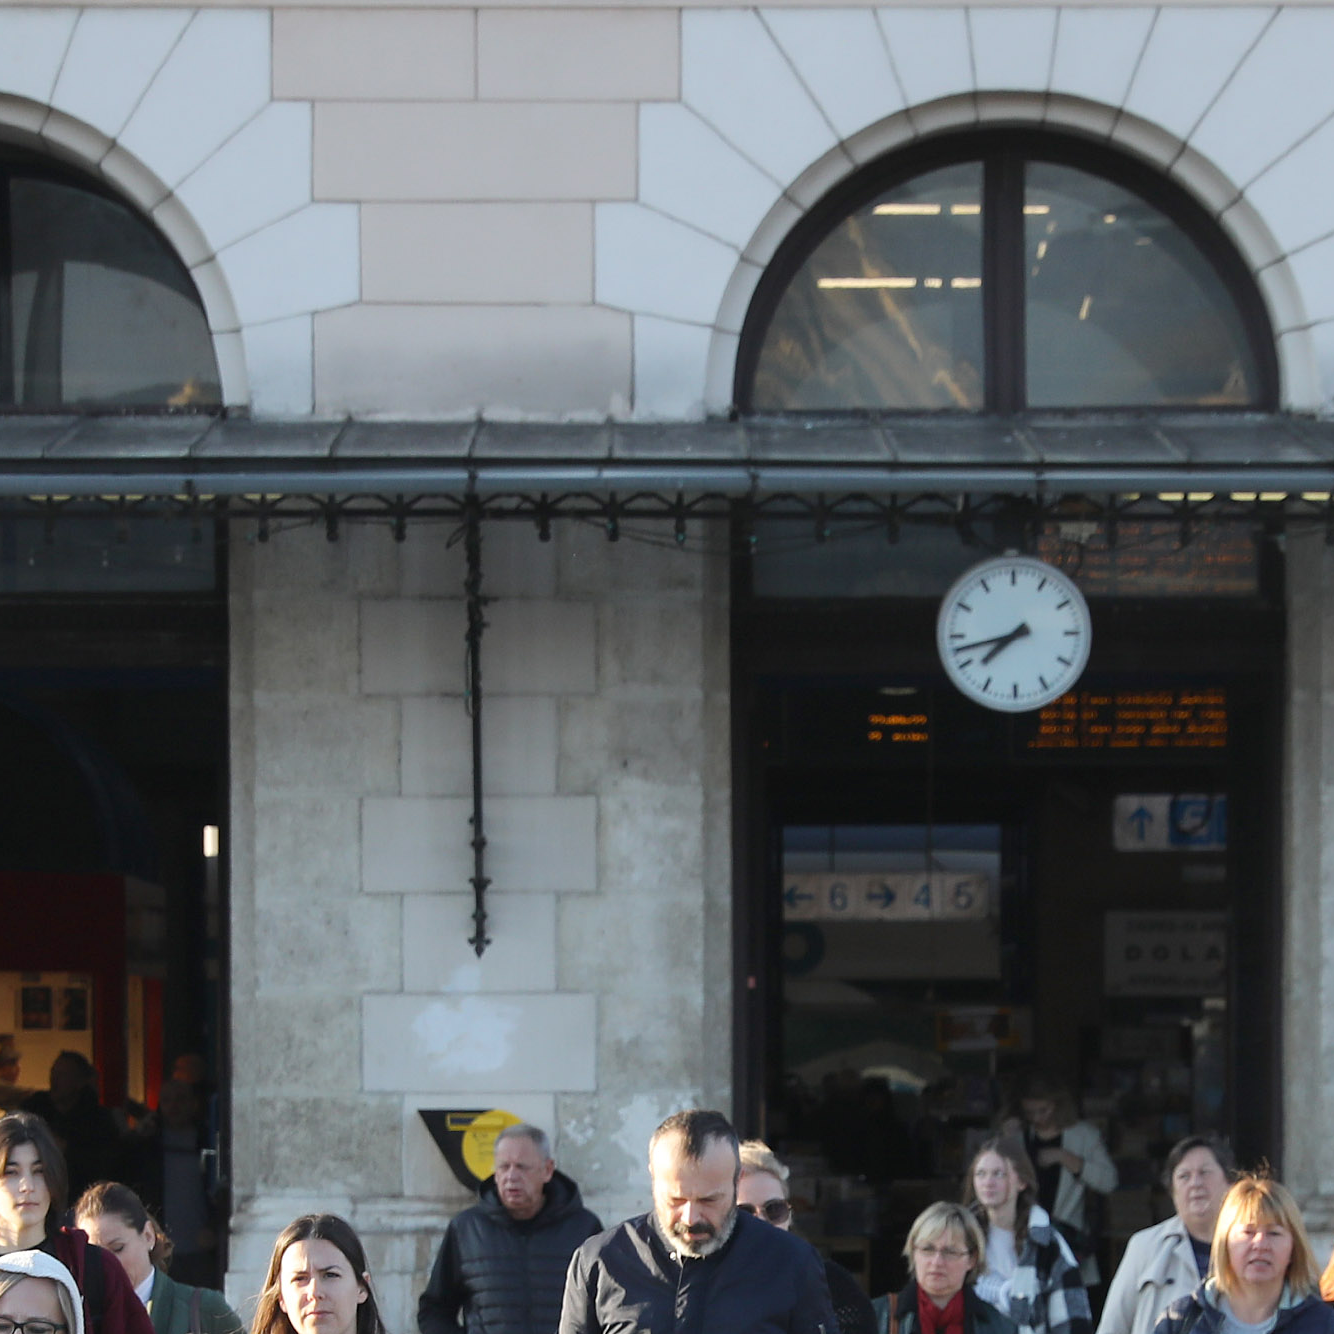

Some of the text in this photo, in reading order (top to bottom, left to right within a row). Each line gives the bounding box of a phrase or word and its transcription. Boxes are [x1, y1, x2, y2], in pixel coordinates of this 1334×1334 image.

[829, 881, 974, 911] 6 4 5
